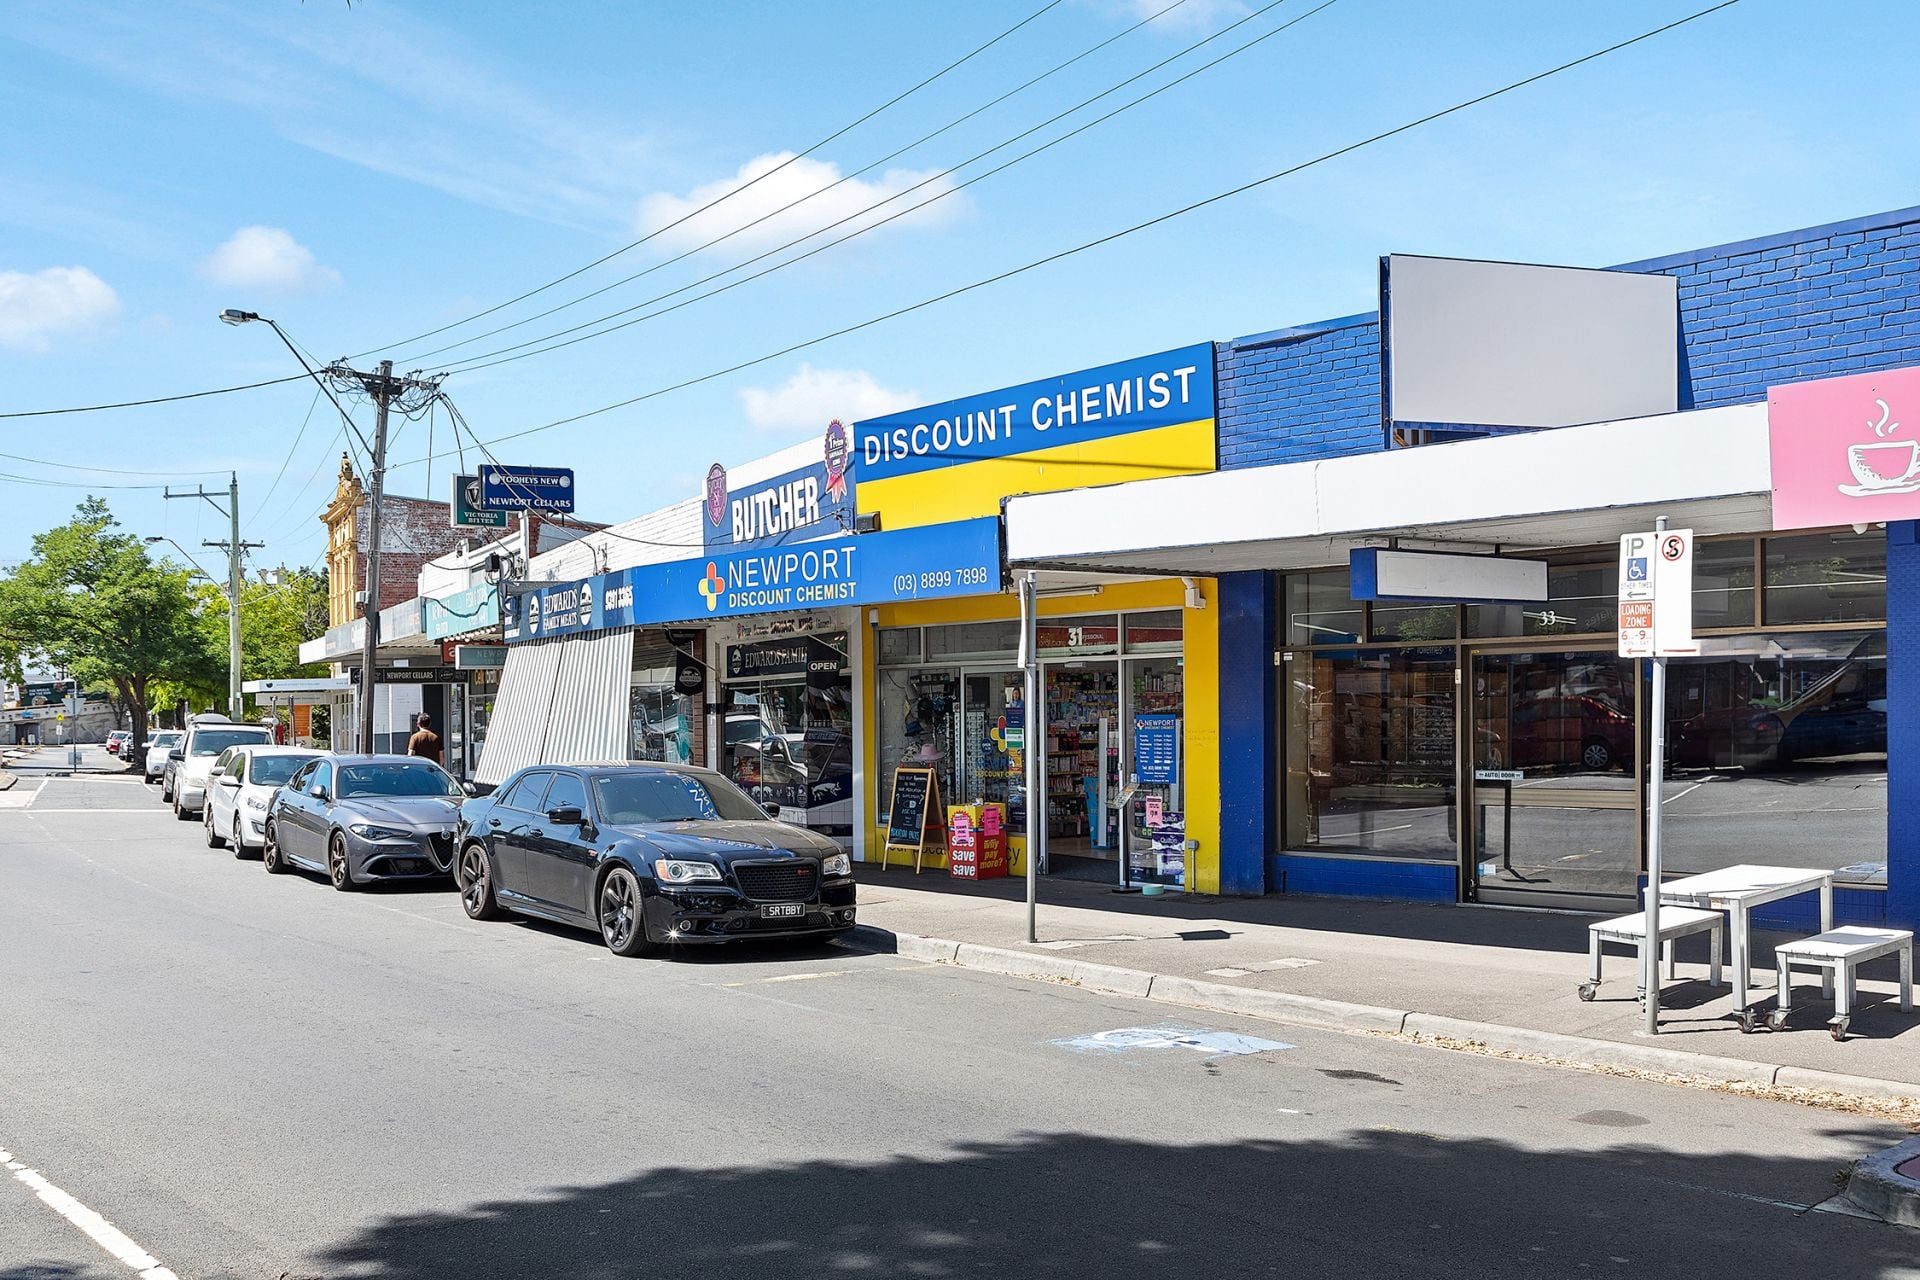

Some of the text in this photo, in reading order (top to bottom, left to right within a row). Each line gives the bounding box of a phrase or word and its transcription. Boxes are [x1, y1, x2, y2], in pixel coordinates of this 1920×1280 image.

[864, 365, 1197, 467] DISCOUNT CHEMIST
[502, 474, 559, 485] TOOHEYS NEW
[489, 496, 571, 508] NEWPORT CELLARS
[464, 511, 499, 520] VICTORIA
[731, 476, 820, 544] BUTCHER
[468, 517, 495, 525] BITTER
[728, 546, 857, 586] NEWPORT
[893, 566, 988, 598] (03) 8899 7898
[543, 588, 578, 614] EDWARDS
[728, 582, 857, 609] DISCOUNT CHEMIST
[1621, 604, 1651, 616] LOADING
[543, 611, 578, 631] FAMILY MEATS
[1539, 611, 1556, 626] 33
[1625, 616, 1648, 628] ZONE
[1067, 627, 1083, 646] 31
[744, 649, 781, 669] EDWARDS
[810, 662, 837, 671] OPEN
[386, 671, 412, 680] NEWPORT
[412, 670, 434, 680] CELLARS
[951, 836, 974, 847] se
[951, 849, 975, 862] save
[984, 850, 998, 861] pay
[979, 857, 1003, 869] more?
[952, 864, 976, 877] save
